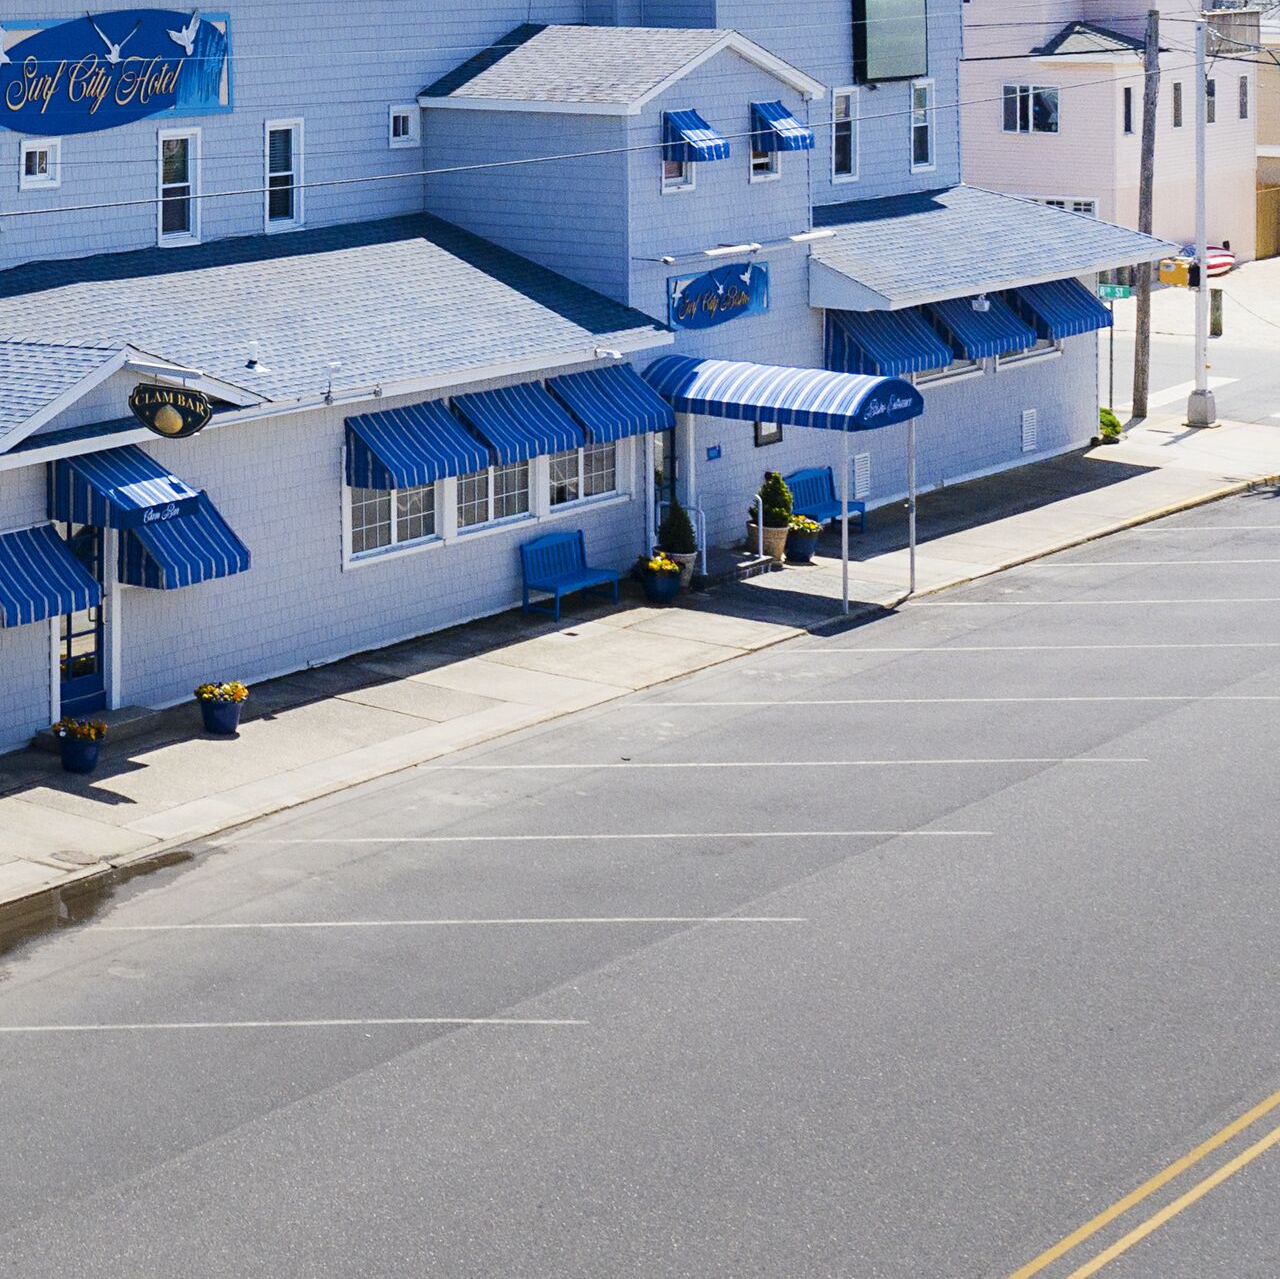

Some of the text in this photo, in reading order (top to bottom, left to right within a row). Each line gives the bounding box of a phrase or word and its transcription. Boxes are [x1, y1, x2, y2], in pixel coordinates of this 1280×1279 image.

[6, 53, 184, 114] Surf City Hotel
[135, 391, 206, 417] CLAM BAR
[143, 503, 180, 524] Clam Bar
